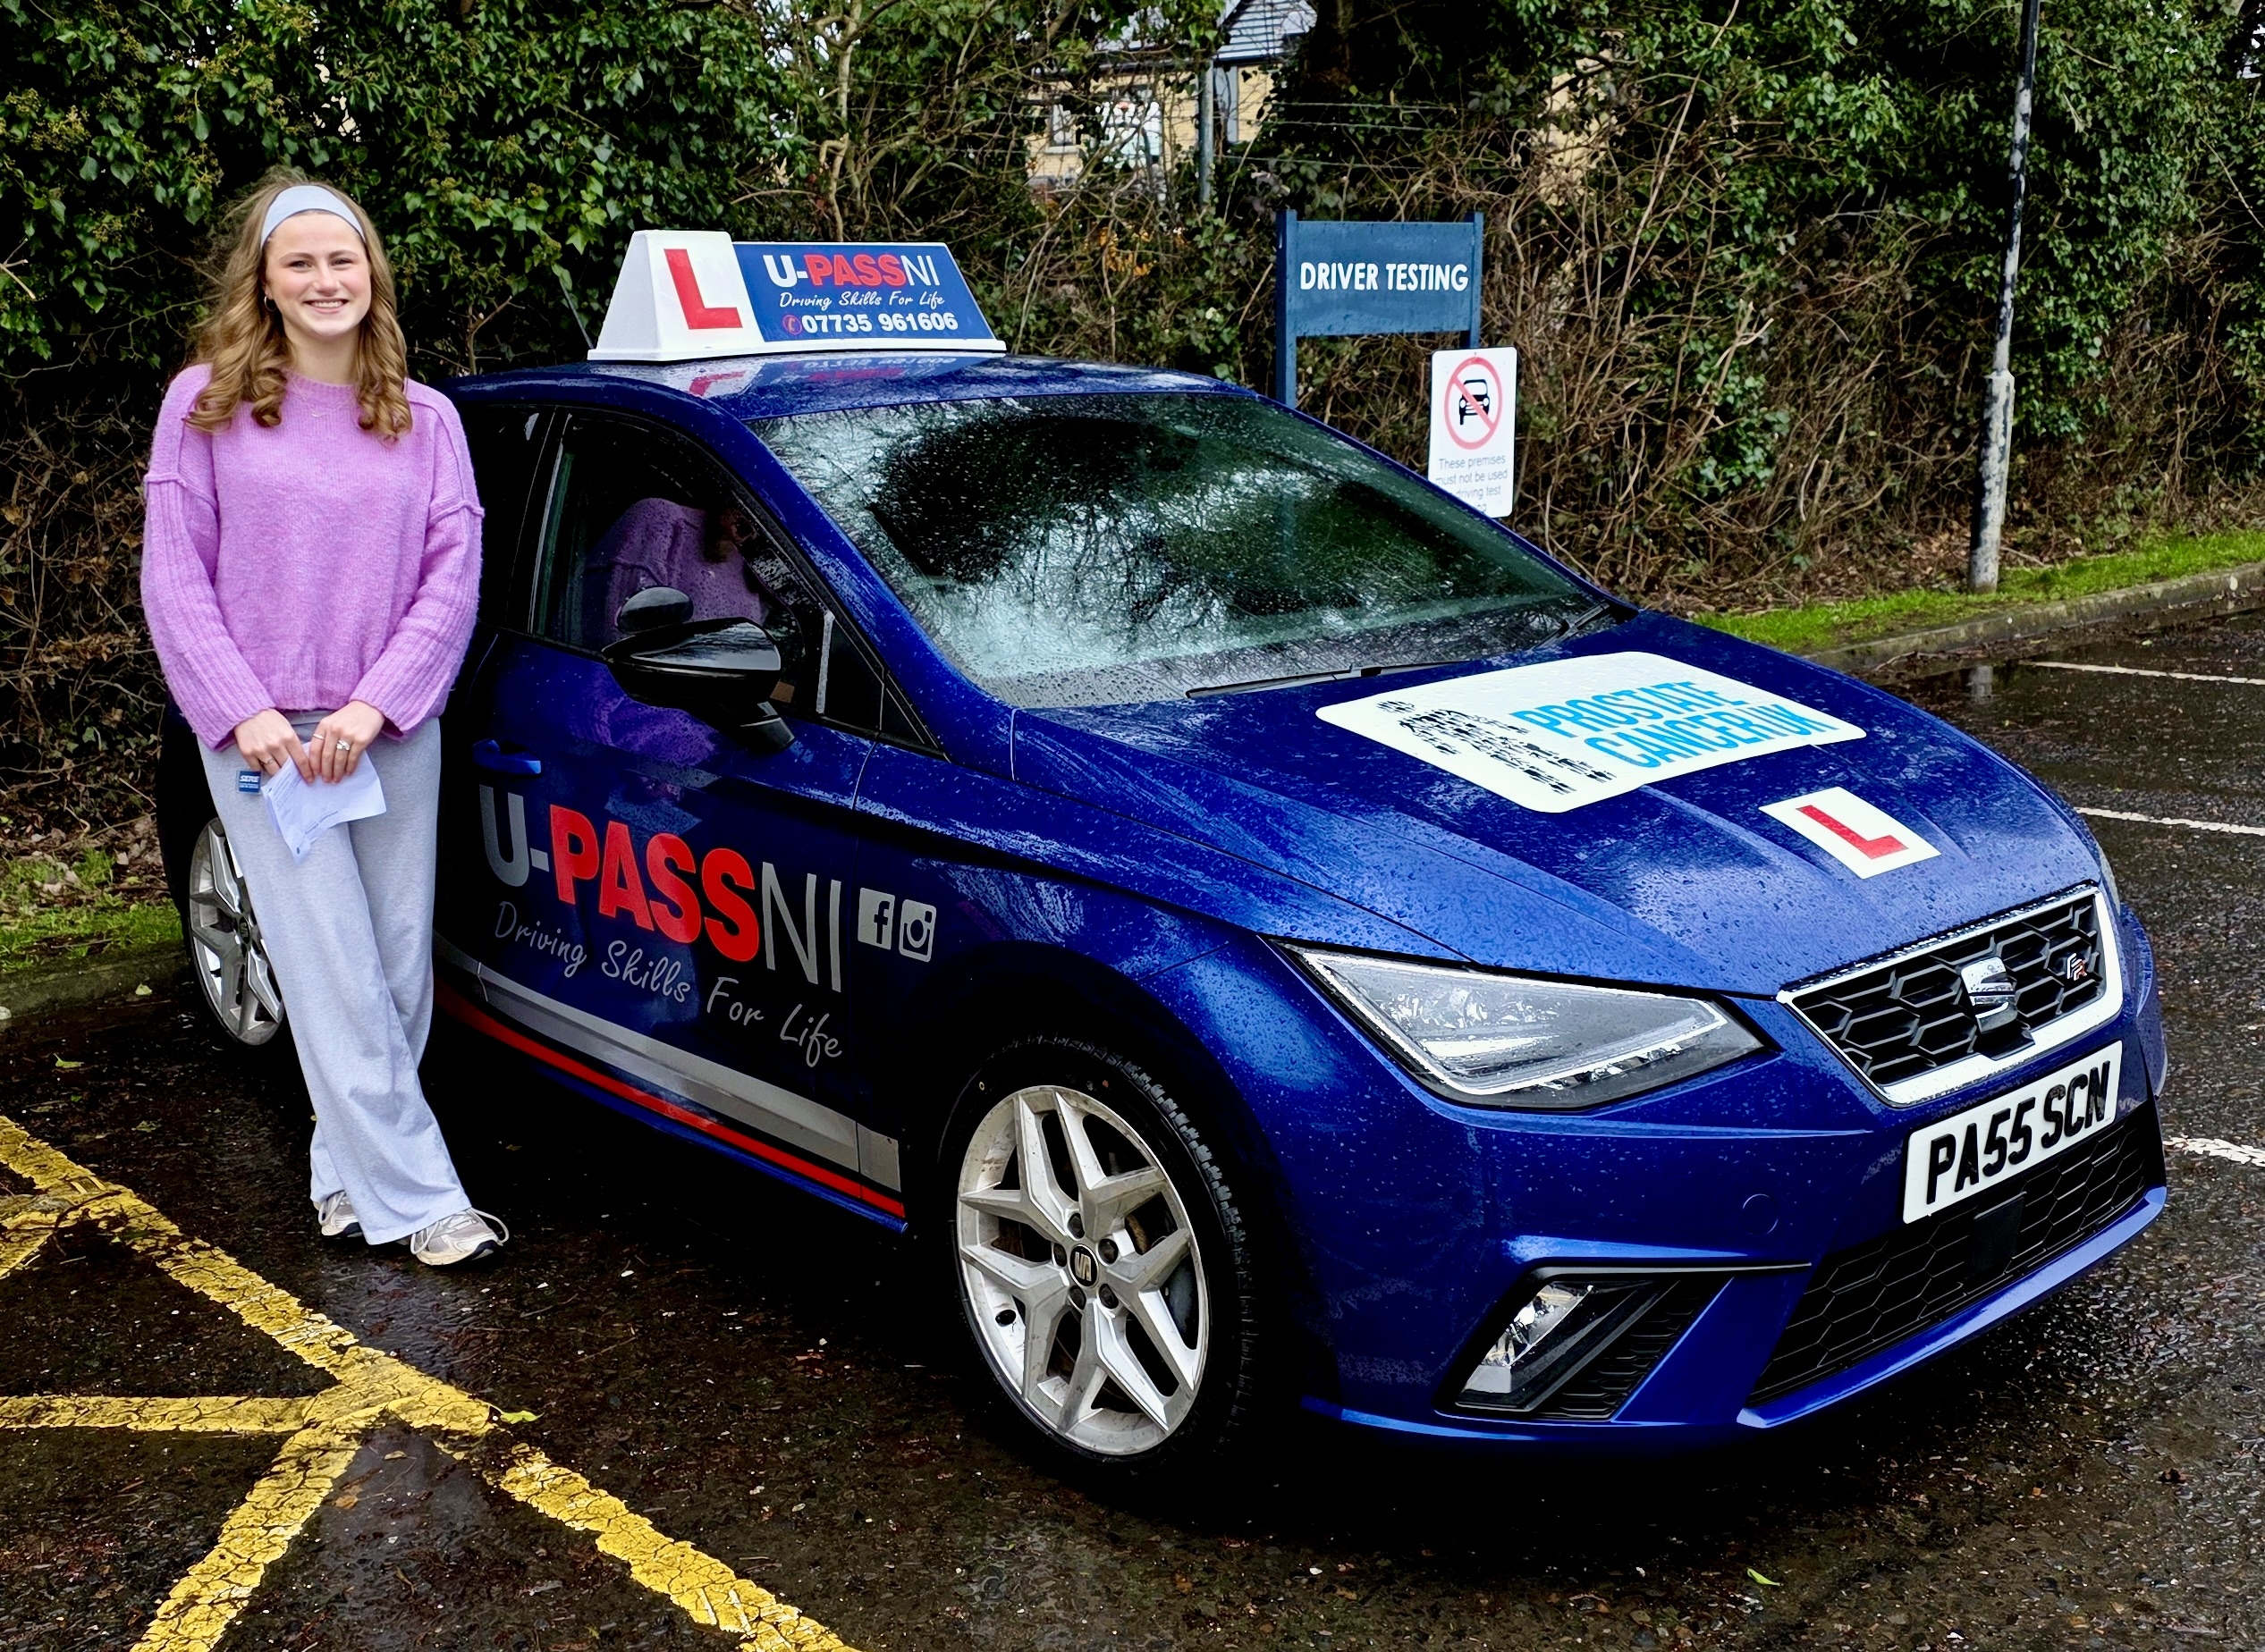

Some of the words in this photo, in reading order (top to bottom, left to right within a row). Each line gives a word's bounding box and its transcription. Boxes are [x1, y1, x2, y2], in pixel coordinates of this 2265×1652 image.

[663, 249, 743, 330] L
[1300, 262, 1378, 290] DRIVER
[1386, 263, 1469, 291] TESTING
[780, 291, 832, 311] Driving
[839, 291, 882, 306] Skills
[889, 291, 914, 306] For
[919, 291, 945, 309] Life
[801, 313, 873, 333] 07735
[878, 312, 959, 332] 961606
[1436, 474, 1457, 485] must
[1459, 473, 1473, 484] not
[1475, 471, 1485, 482] be
[1488, 468, 1508, 481] used
[1439, 458, 1465, 469] These
[1468, 455, 1506, 469] premises
[1486, 485, 1501, 496] test
[1509, 681, 1751, 738] PROSTATE
[1794, 804, 1908, 859] L
[494, 901, 587, 978] Driving
[601, 940, 691, 1003] Skills
[706, 976, 765, 1026] For
[780, 1003, 842, 1067] Life
[1926, 1097, 2036, 1205] PA55
[2041, 1060, 2110, 1149] SCN
